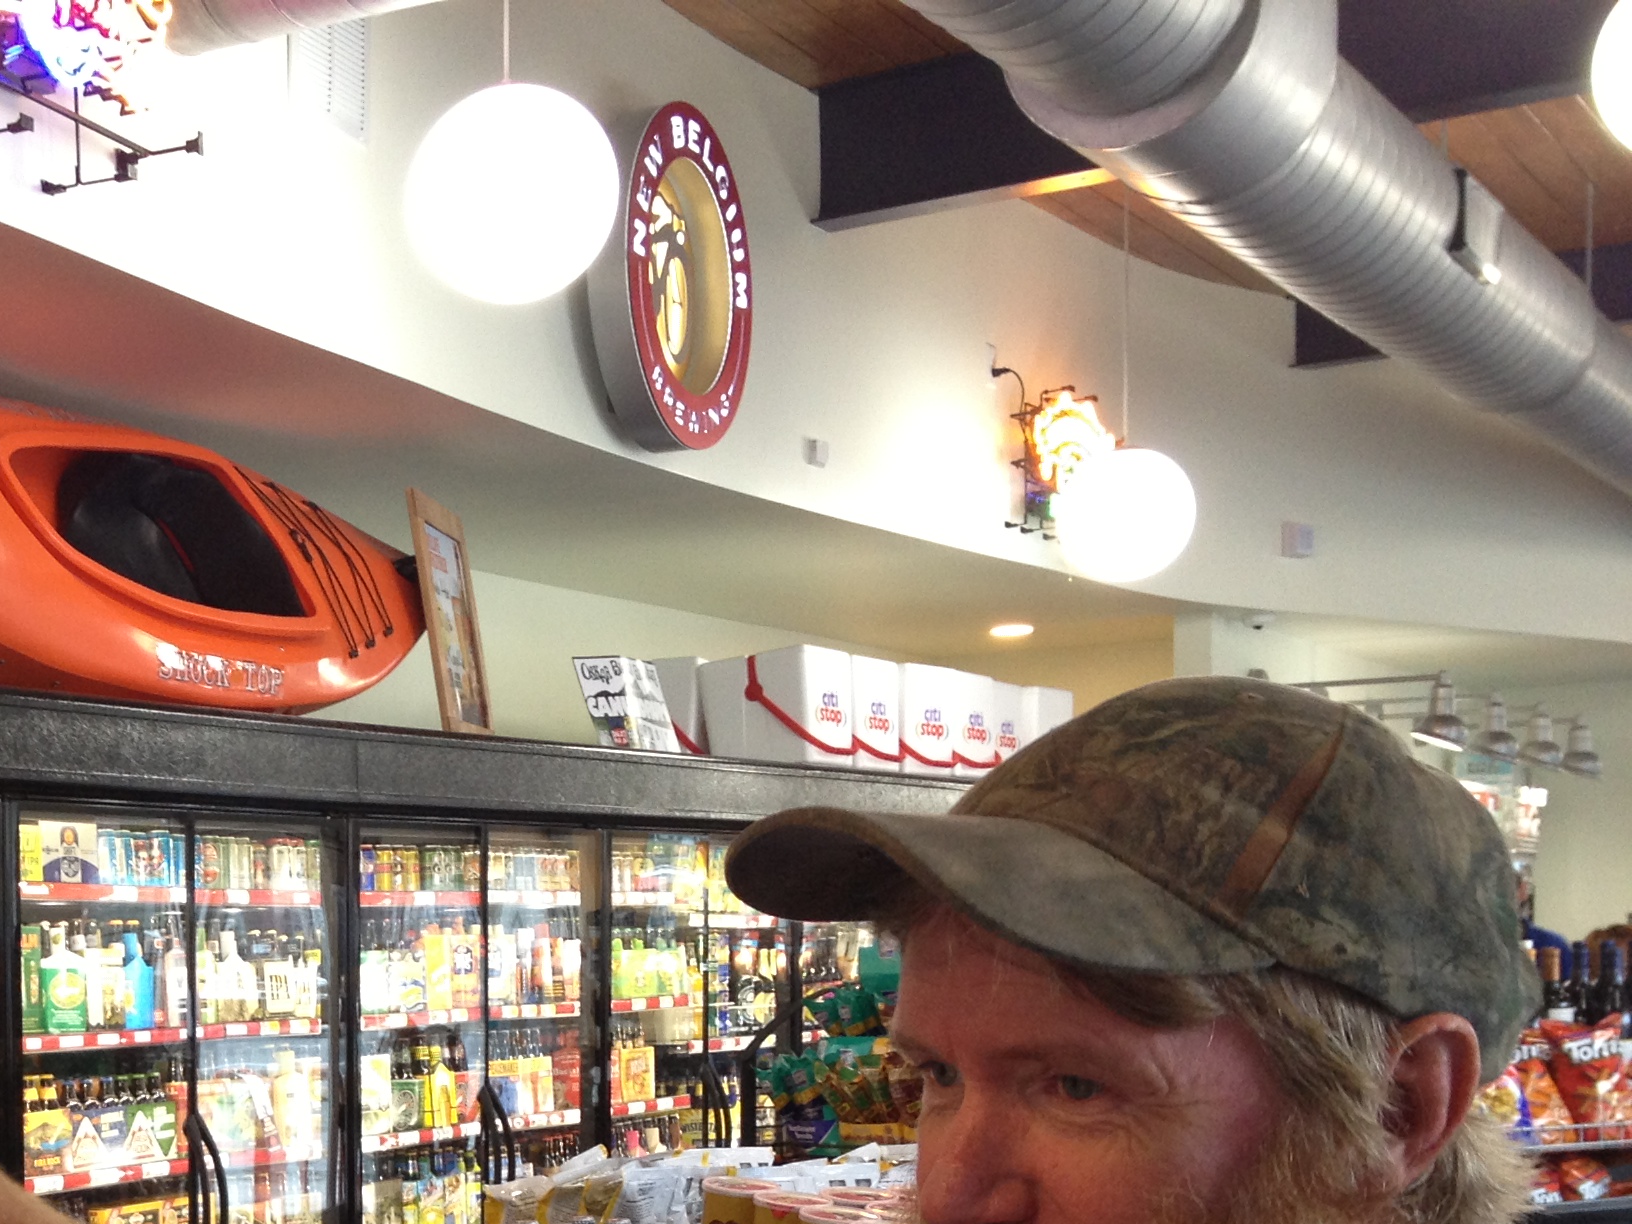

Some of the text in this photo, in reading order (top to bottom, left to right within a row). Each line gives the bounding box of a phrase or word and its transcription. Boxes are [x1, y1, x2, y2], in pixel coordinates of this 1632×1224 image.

[633, 114, 749, 309] NEW BELGIUM
[158, 644, 285, 695] SHOCK TOP
[822, 692, 839, 708] citi
[870, 702, 887, 716] citi
[819, 707, 843, 727] stop
[924, 708, 941, 722] citi
[969, 712, 984, 727] citi
[868, 715, 891, 734] stop
[920, 721, 945, 740] stop
[967, 726, 988, 744] stop
